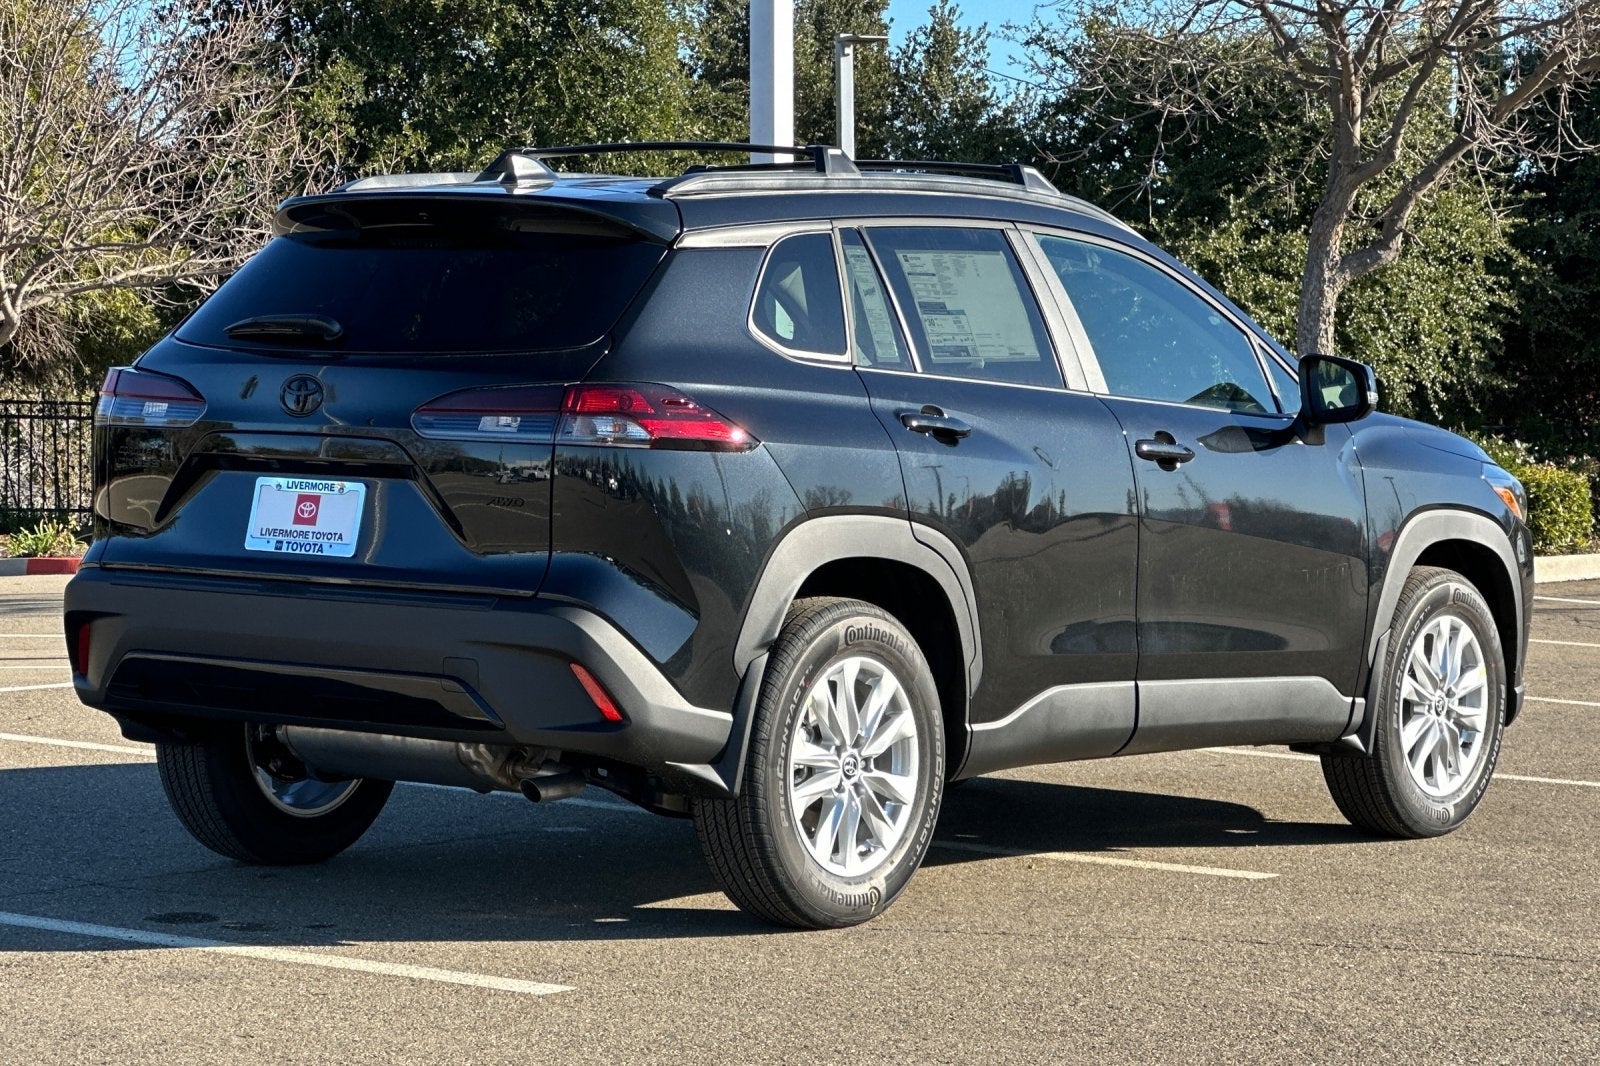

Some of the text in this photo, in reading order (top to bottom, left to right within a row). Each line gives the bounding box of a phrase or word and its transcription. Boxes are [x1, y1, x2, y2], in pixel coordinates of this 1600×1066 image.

[286, 481, 335, 492] LIVERMORE
[260, 527, 343, 541] LIVERMORE TOYOTA
[285, 541, 324, 554] TOYOTA
[844, 622, 907, 655] Continental
